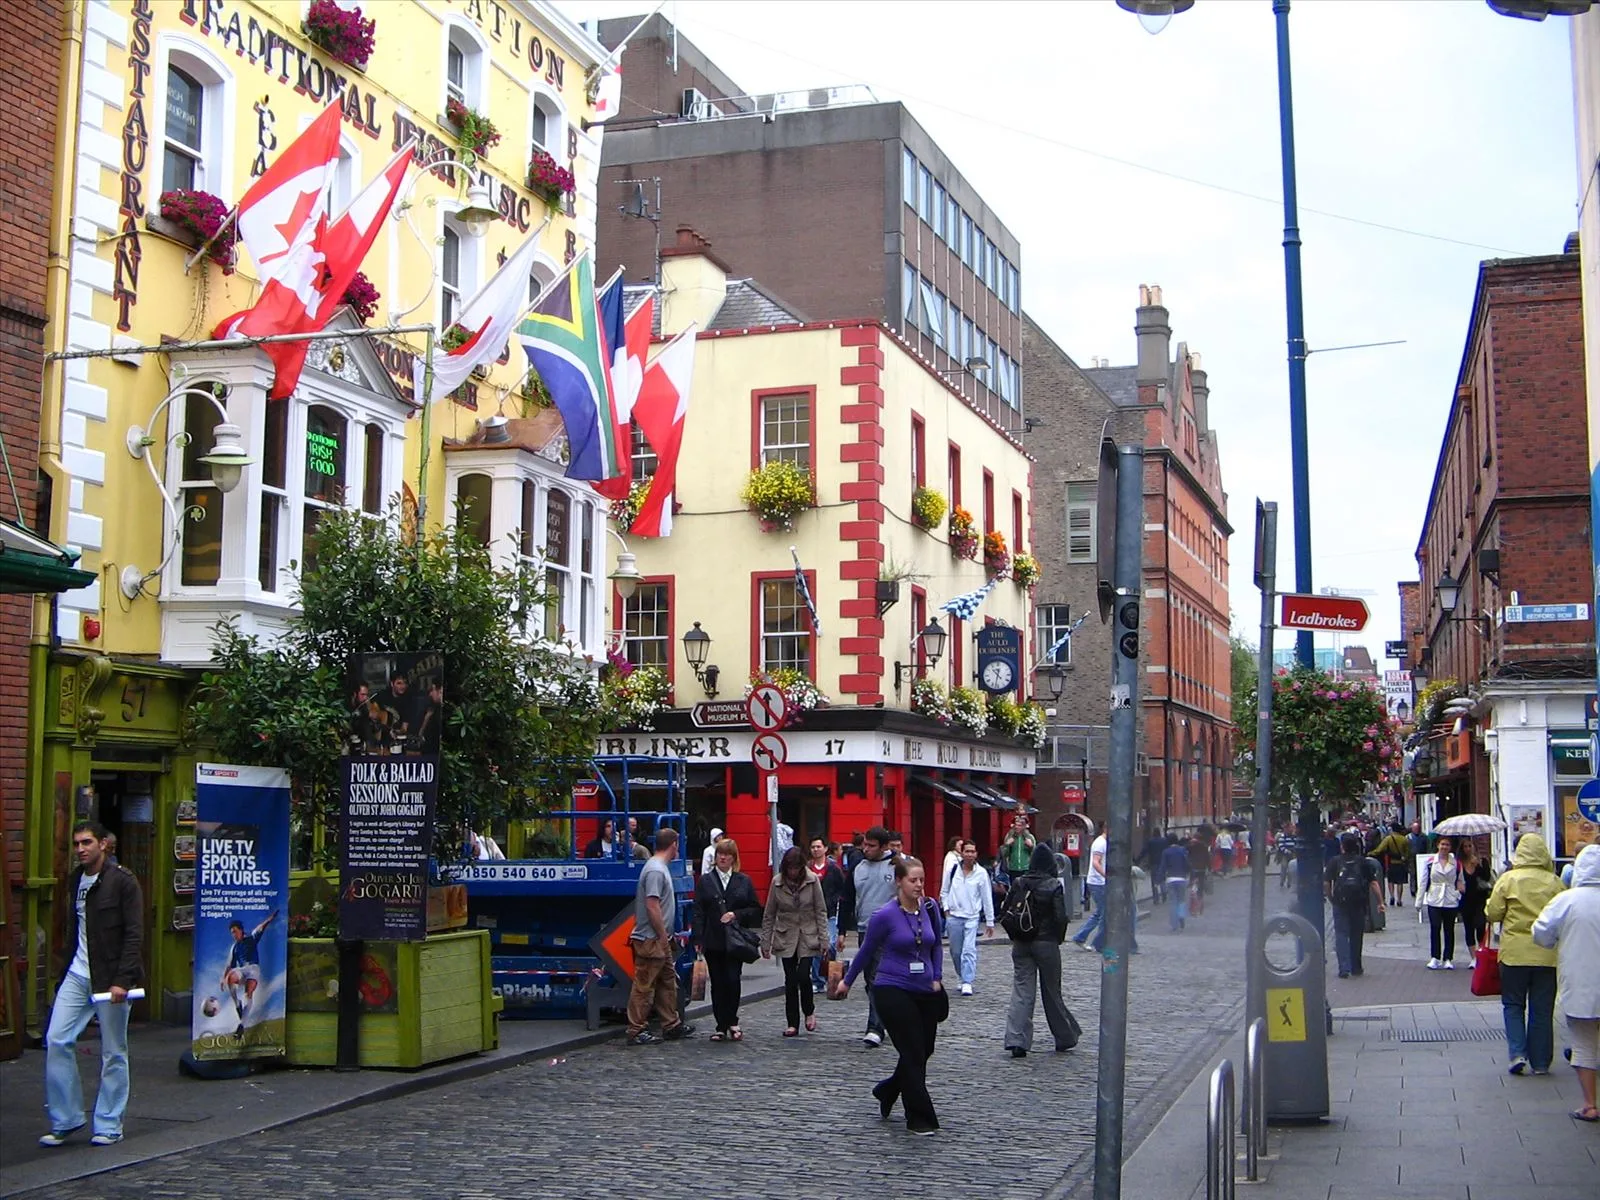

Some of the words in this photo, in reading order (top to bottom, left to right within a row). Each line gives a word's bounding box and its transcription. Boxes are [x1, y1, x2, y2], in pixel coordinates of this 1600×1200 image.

[310, 441, 333, 461] IRISH
[310, 457, 336, 476] FOOD
[1289, 610, 1358, 628] Ladbrokes
[1579, 608, 1586, 616] 2
[707, 704, 741, 713] NATIONAL
[707, 714, 738, 722] MUSEUM
[825, 738, 845, 756] 17
[904, 737, 923, 761] THE
[937, 741, 958, 764] AULD
[214, 769, 239, 778] SPORTS
[350, 762, 378, 783] FOLK
[379, 762, 388, 783] &
[390, 762, 434, 783] BALLAD
[349, 783, 400, 803] SESSIONS
[401, 791, 410, 803] AT
[411, 791, 424, 803] THE
[349, 804, 371, 816] OLIVER
[371, 804, 379, 816] ST
[397, 804, 427, 816] GOGARTY
[202, 839, 233, 854] LIVE
[235, 840, 254, 855] TV
[201, 854, 256, 870] SPORTS
[201, 870, 271, 886] FIXTURES
[465, 867, 497, 879] 1850
[502, 867, 526, 879] 540
[531, 867, 556, 879] 640
[351, 877, 424, 898] GOGARTY
